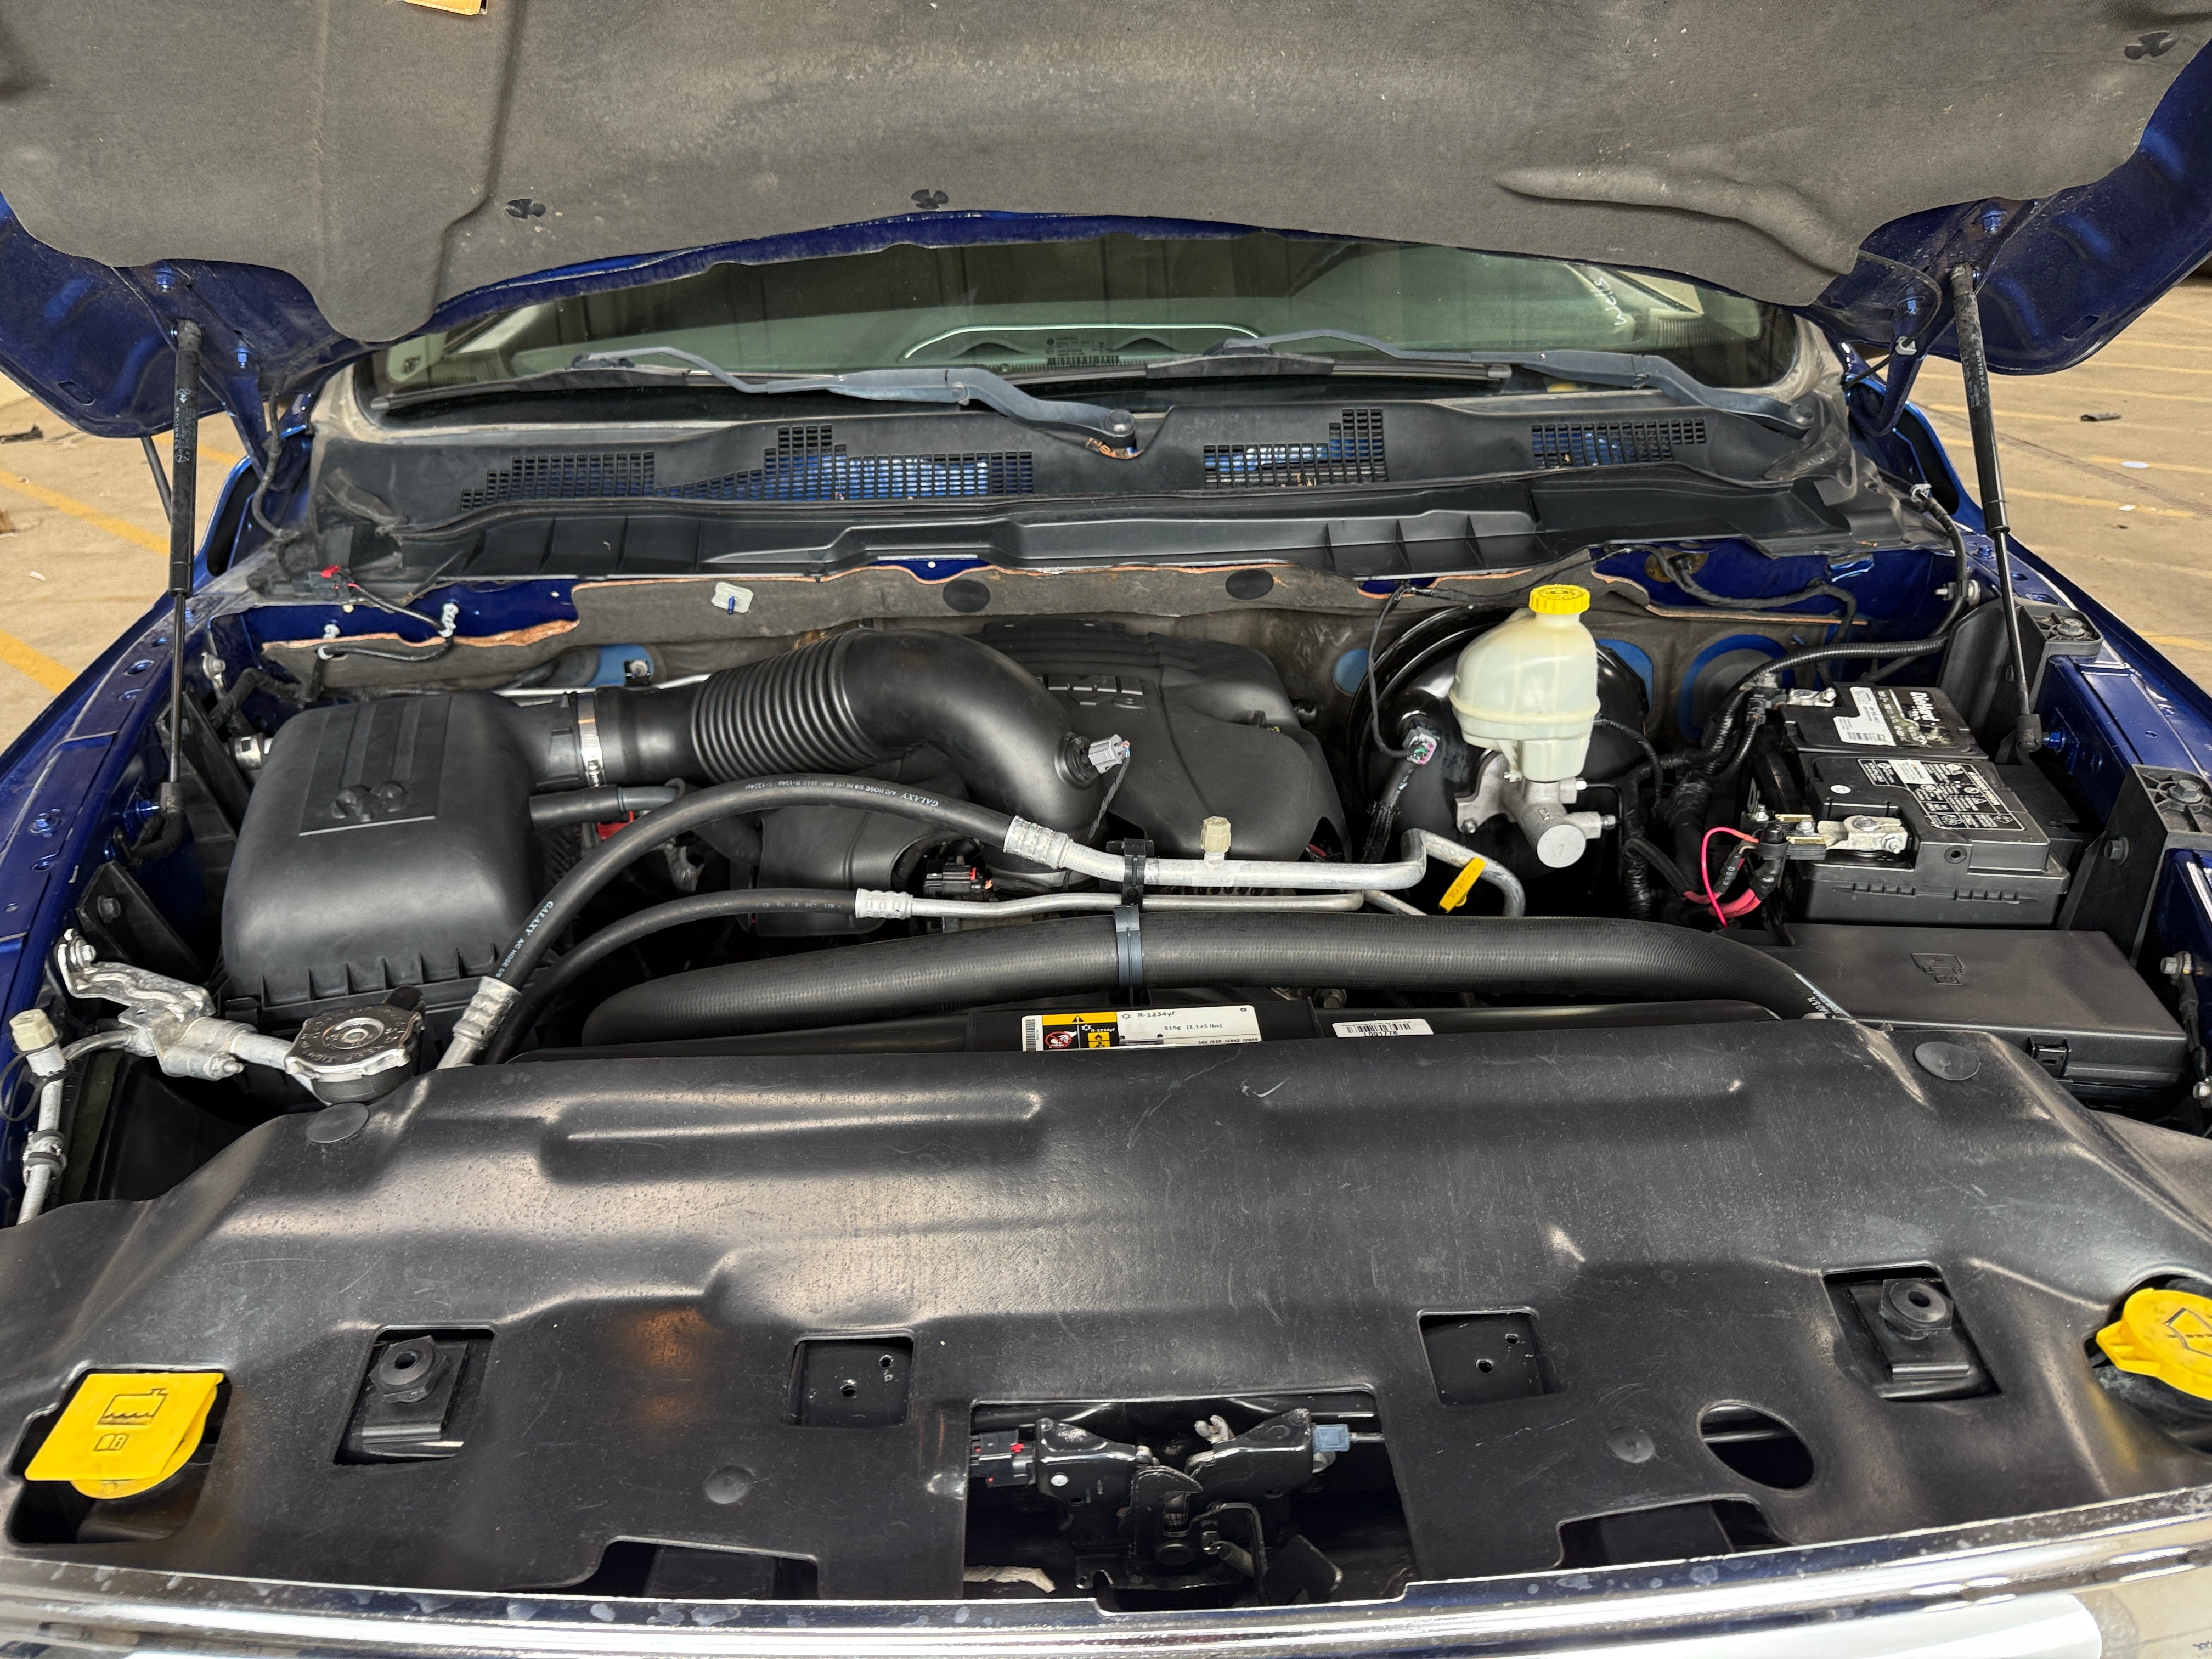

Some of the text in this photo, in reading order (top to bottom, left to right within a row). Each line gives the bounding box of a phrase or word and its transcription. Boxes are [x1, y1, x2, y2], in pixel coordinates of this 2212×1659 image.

[1909, 691, 1940, 722] DieHard
[866, 785, 884, 794] HOSE
[885, 788, 898, 797] A/C
[899, 792, 940, 808] GALAXY
[524, 900, 554, 936] GALAXY
[514, 937, 526, 950] A/C
[501, 949, 518, 968] HOSE
[1137, 1011, 1175, 1019] R-1234yf
